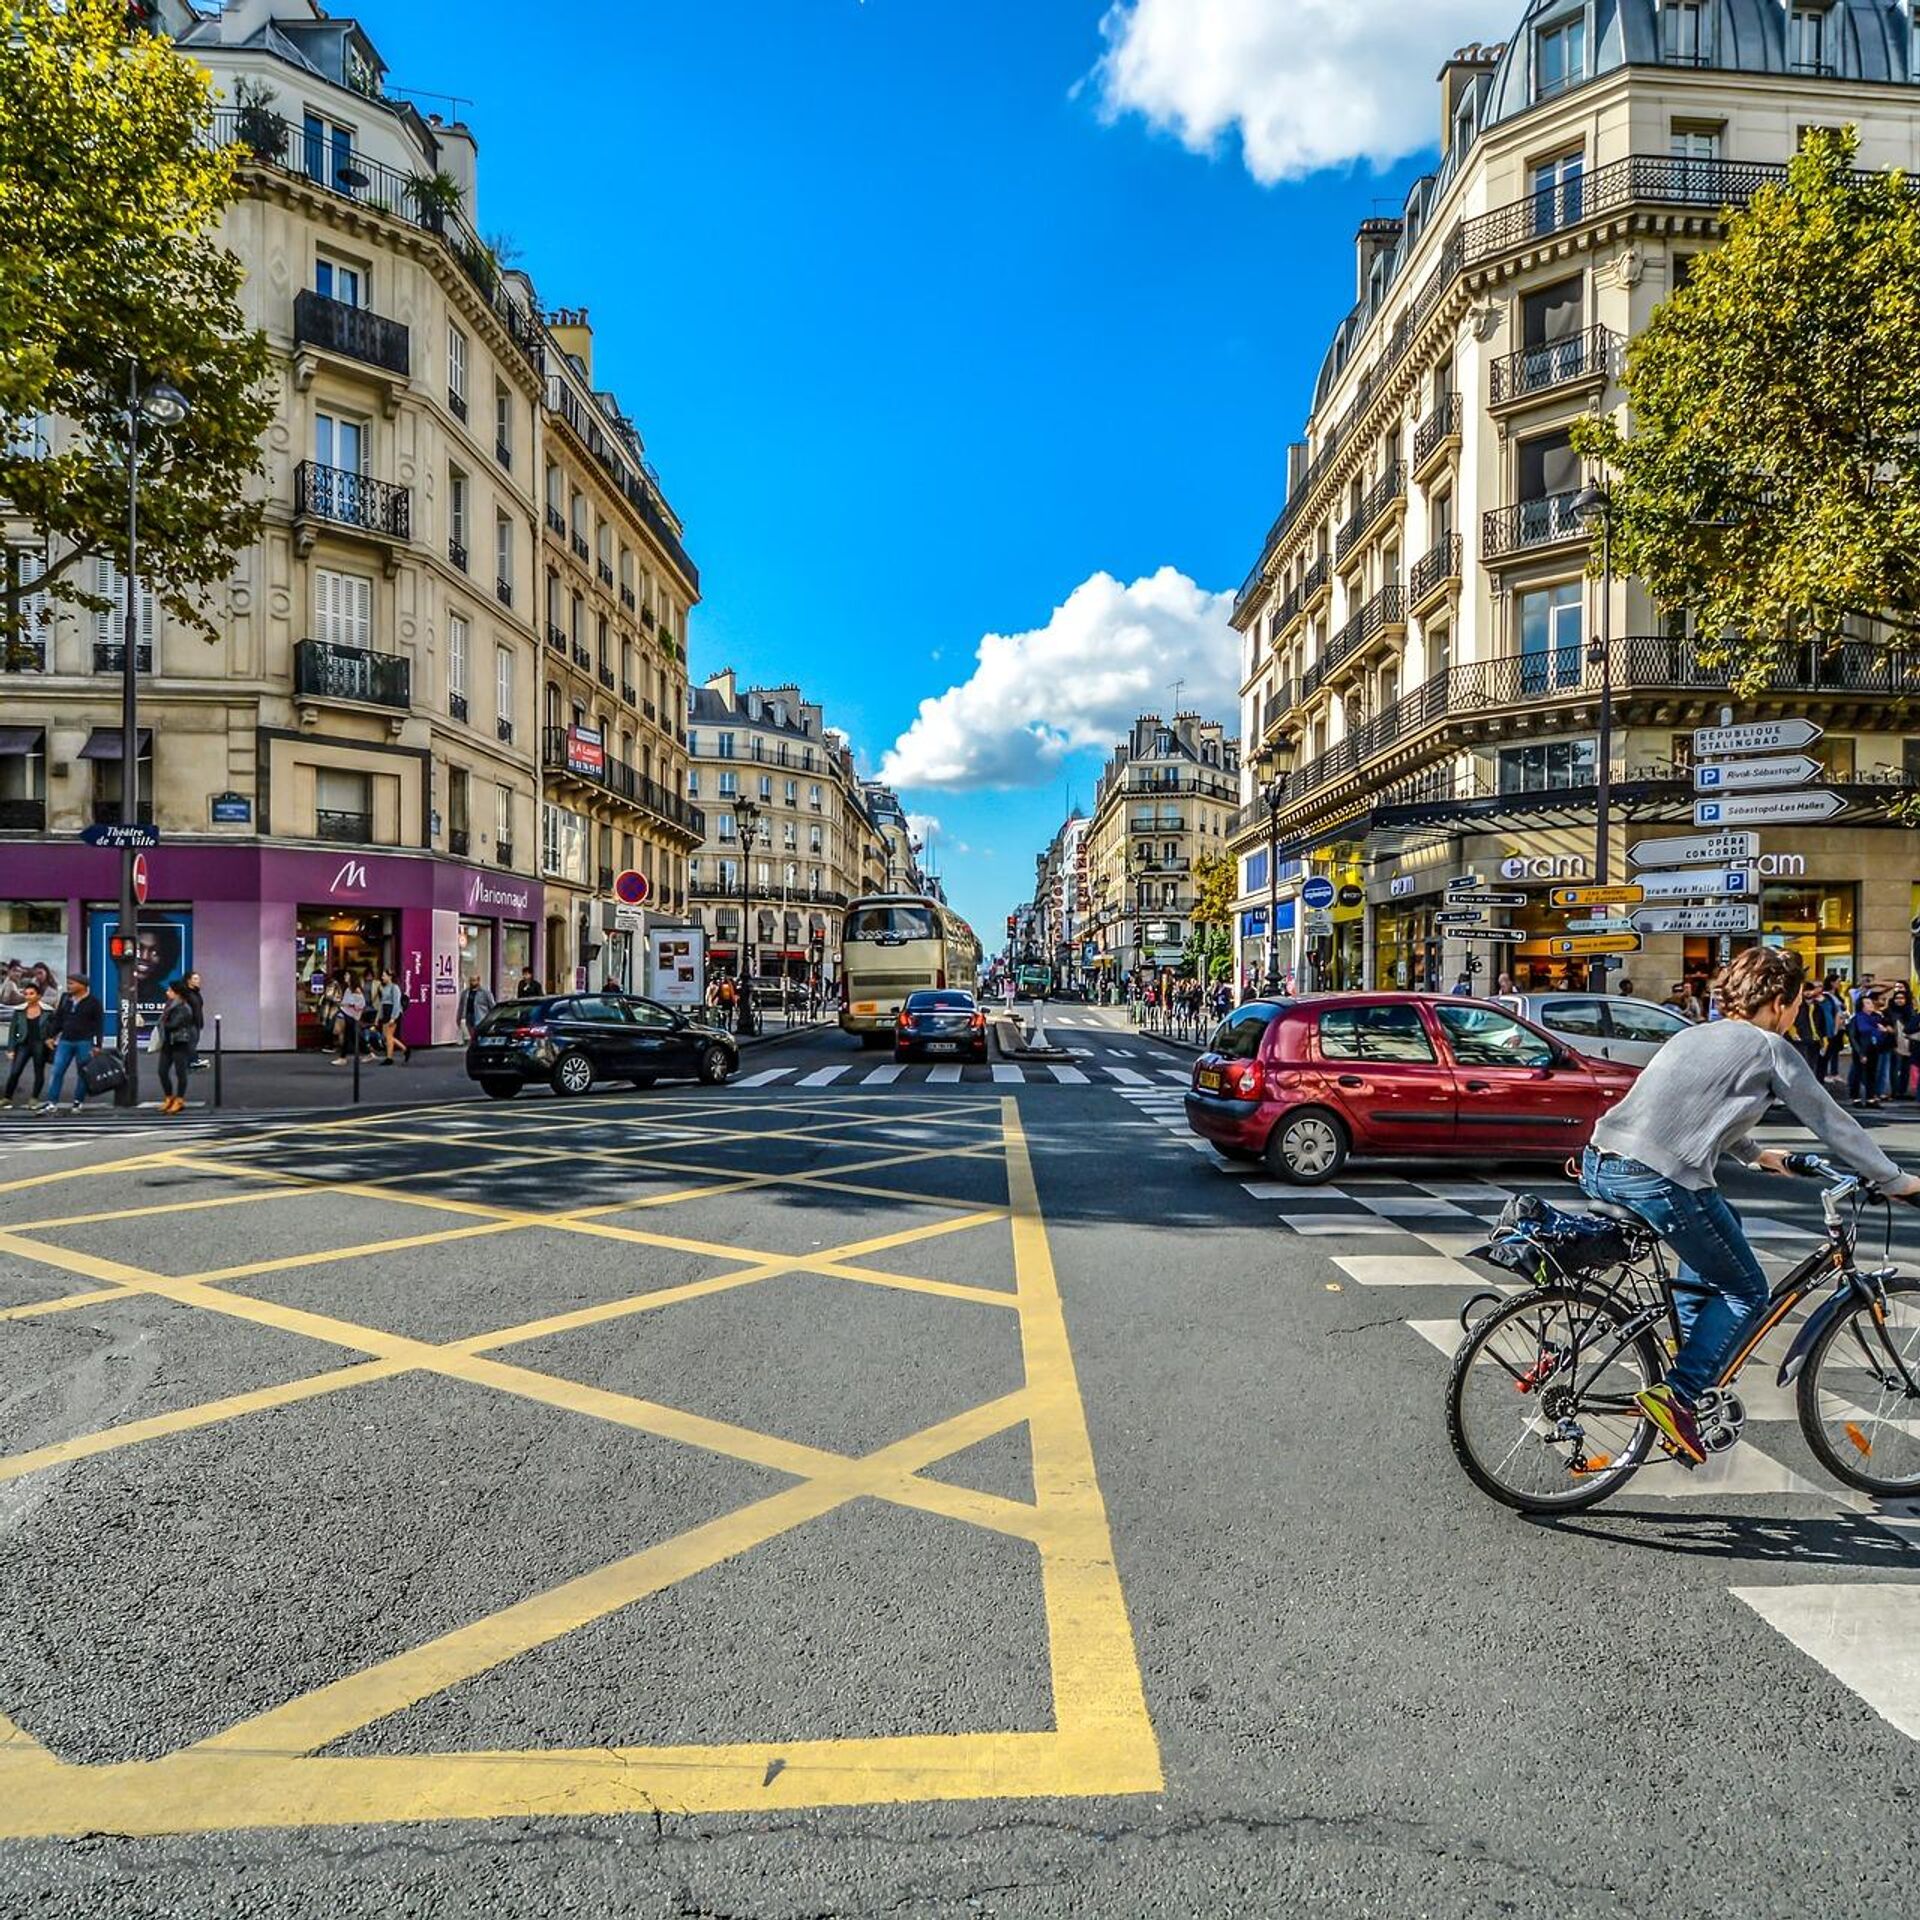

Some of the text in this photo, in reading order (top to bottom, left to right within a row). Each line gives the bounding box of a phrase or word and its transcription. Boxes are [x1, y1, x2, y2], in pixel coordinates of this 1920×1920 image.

[1700, 725, 1781, 741] RÉPUBLIQUE
[1700, 736, 1779, 751] STALINGRAD
[1796, 801, 1825, 811] Halles
[106, 826, 144, 837] Théâtre
[96, 836, 156, 846] de la Ville
[1708, 835, 1745, 847] OPÉRA
[1685, 846, 1746, 858] CONCORDE
[330, 860, 367, 892] M
[469, 876, 528, 908] Marionnaud
[1646, 876, 1741, 896] orum des Halles P
[1678, 911, 1710, 919] Mairie
[1715, 909, 1727, 918] du
[1662, 918, 1746, 929] Palais du Louvre
